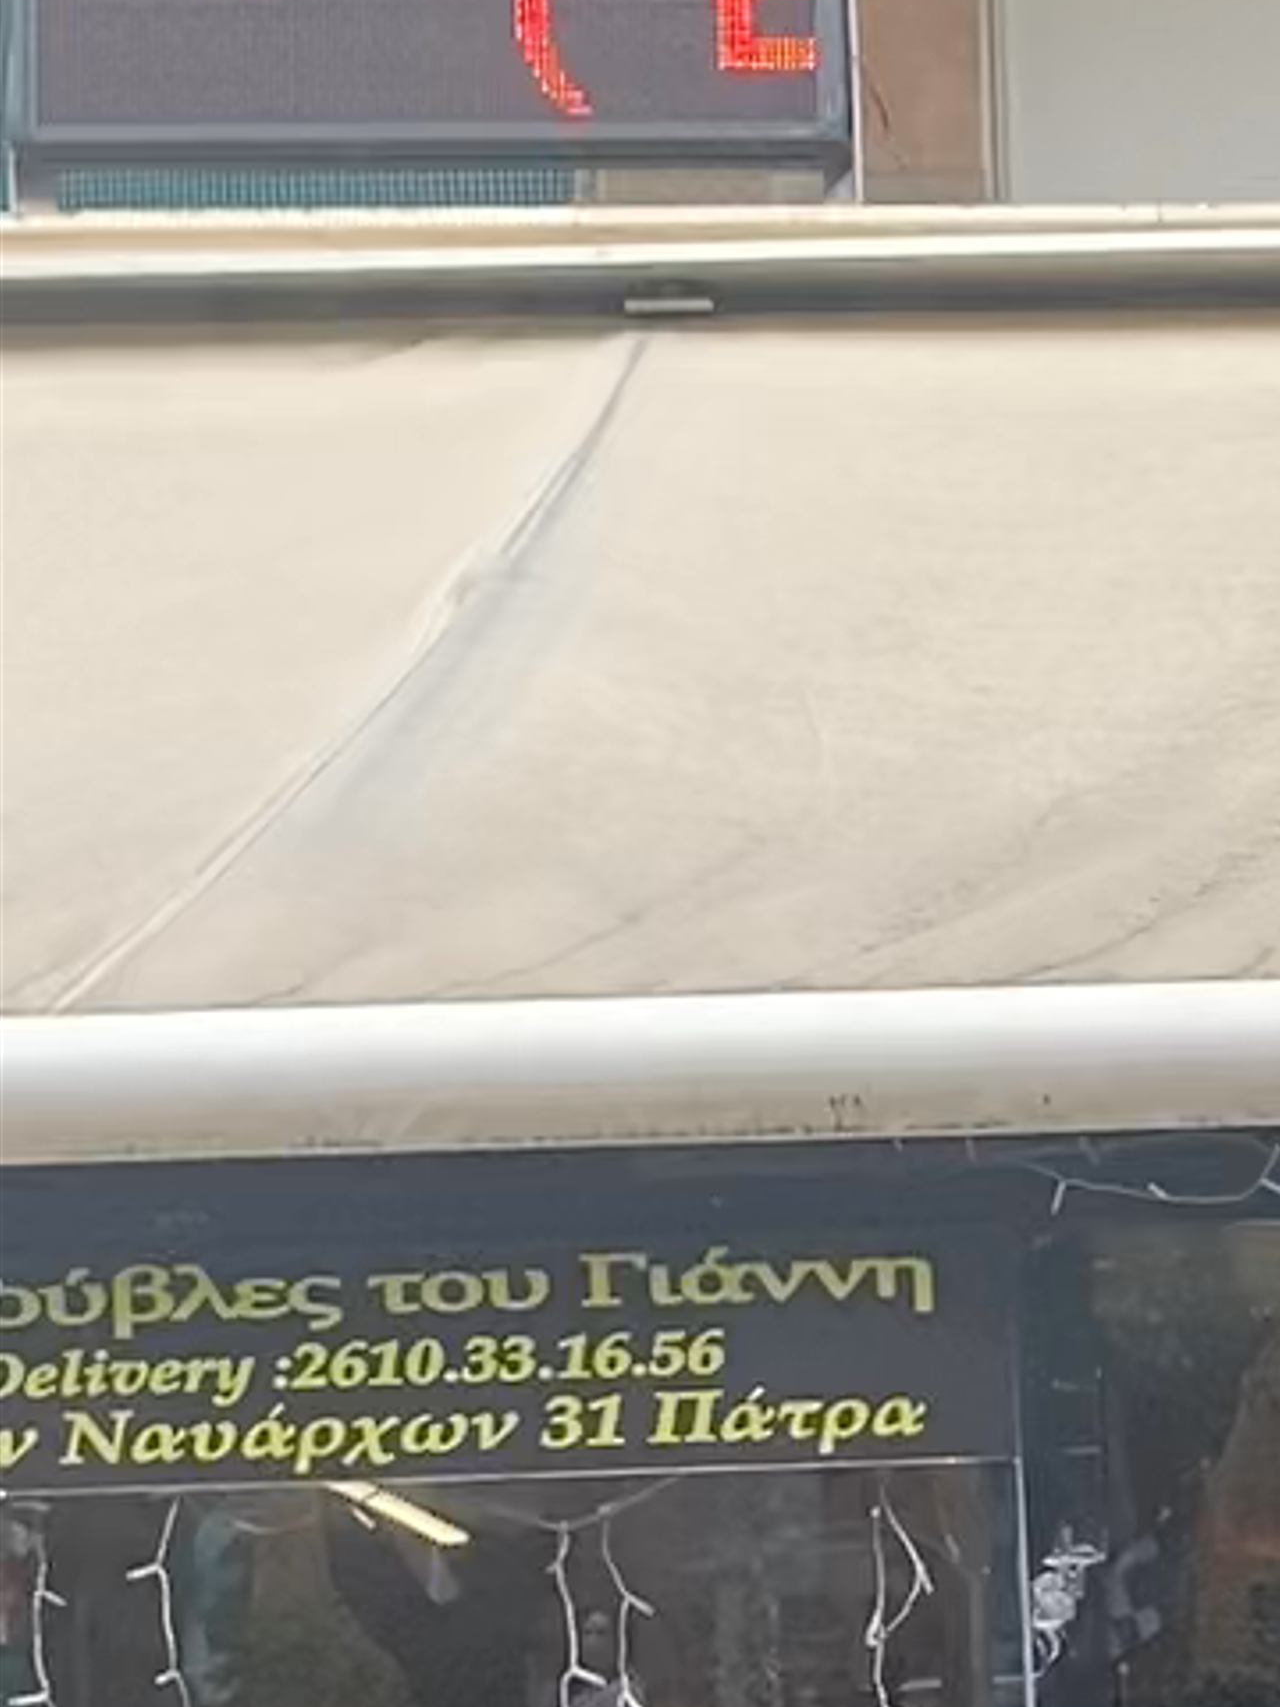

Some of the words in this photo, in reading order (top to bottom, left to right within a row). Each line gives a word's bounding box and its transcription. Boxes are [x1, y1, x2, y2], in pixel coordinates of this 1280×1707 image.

[367, 1268, 551, 1315] του
[578, 1246, 935, 1312] Γιάννη
[59, 1403, 519, 1475] Ναυάρχων
[539, 1393, 626, 1449] 31
[647, 1386, 927, 1455] Πάτρα
